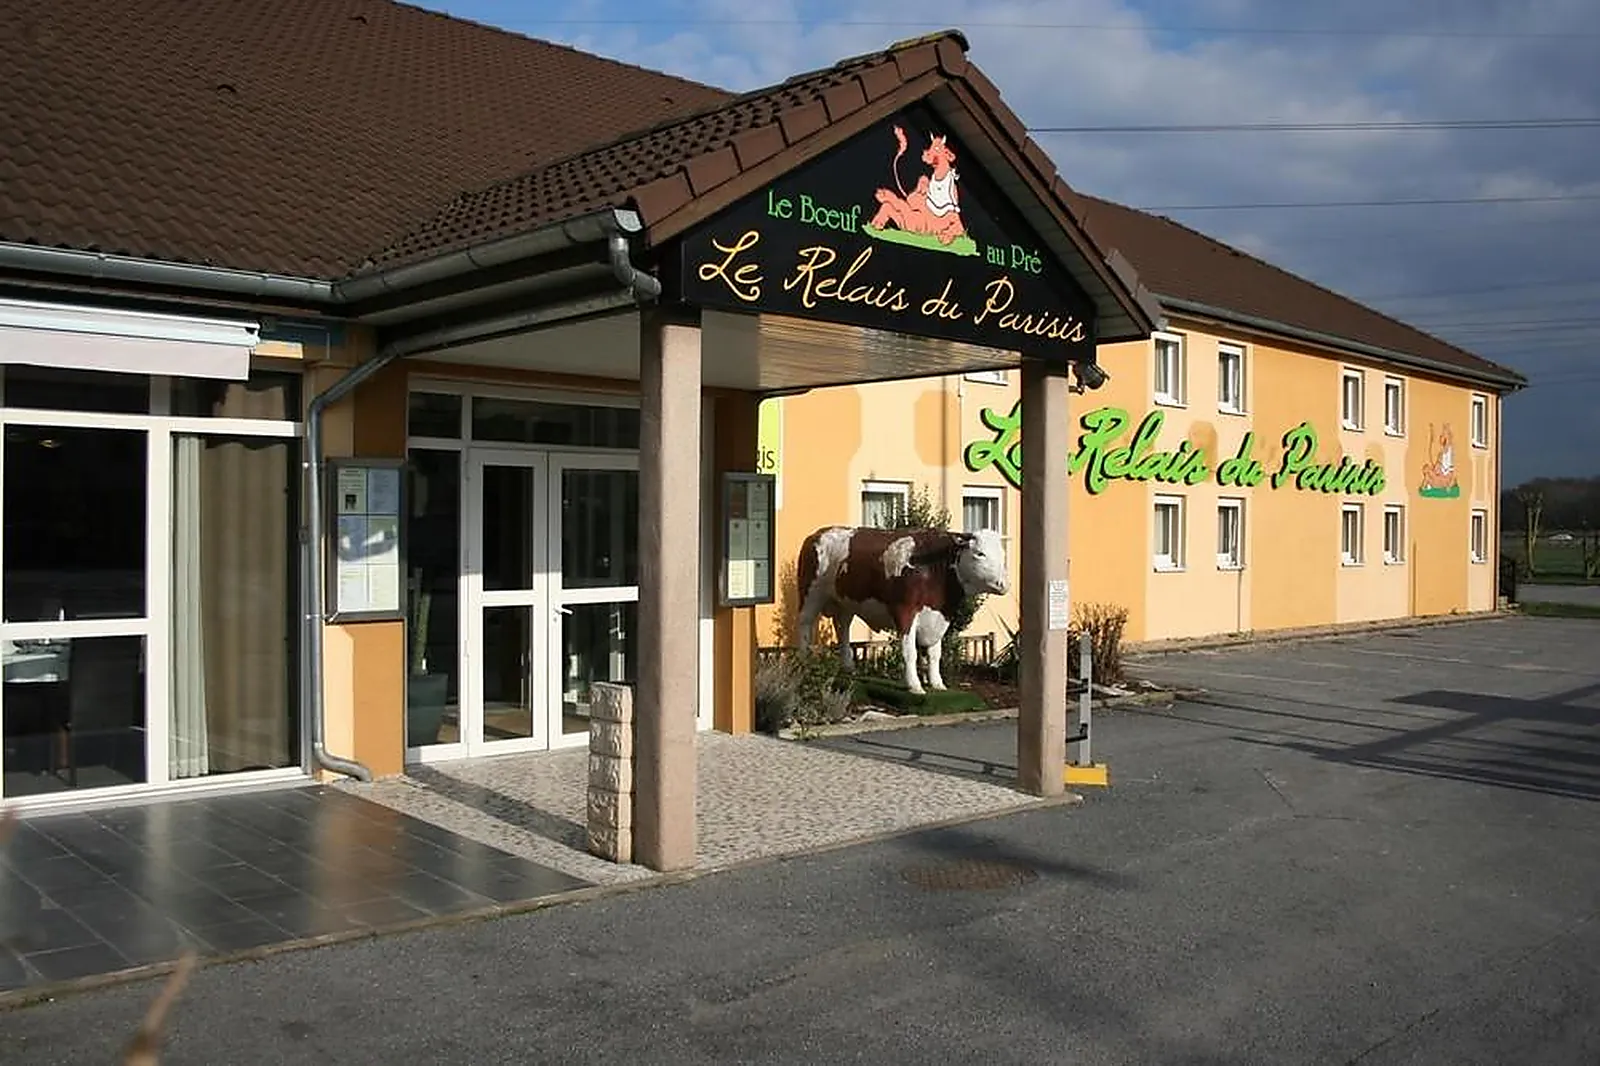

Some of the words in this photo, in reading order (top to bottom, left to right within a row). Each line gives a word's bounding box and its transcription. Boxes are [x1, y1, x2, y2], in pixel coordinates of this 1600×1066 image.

[767, 189, 794, 220] Le
[698, 230, 764, 303] Le
[783, 244, 911, 309] Relais
[921, 278, 964, 321] du
[973, 275, 1087, 343] Parisis
[985, 246, 1006, 267] au
[1010, 243, 1043, 275] Pré
[963, 399, 1023, 492] L
[1067, 407, 1209, 496] Relais
[1215, 431, 1265, 488] du
[1270, 421, 1387, 497] Parisis
